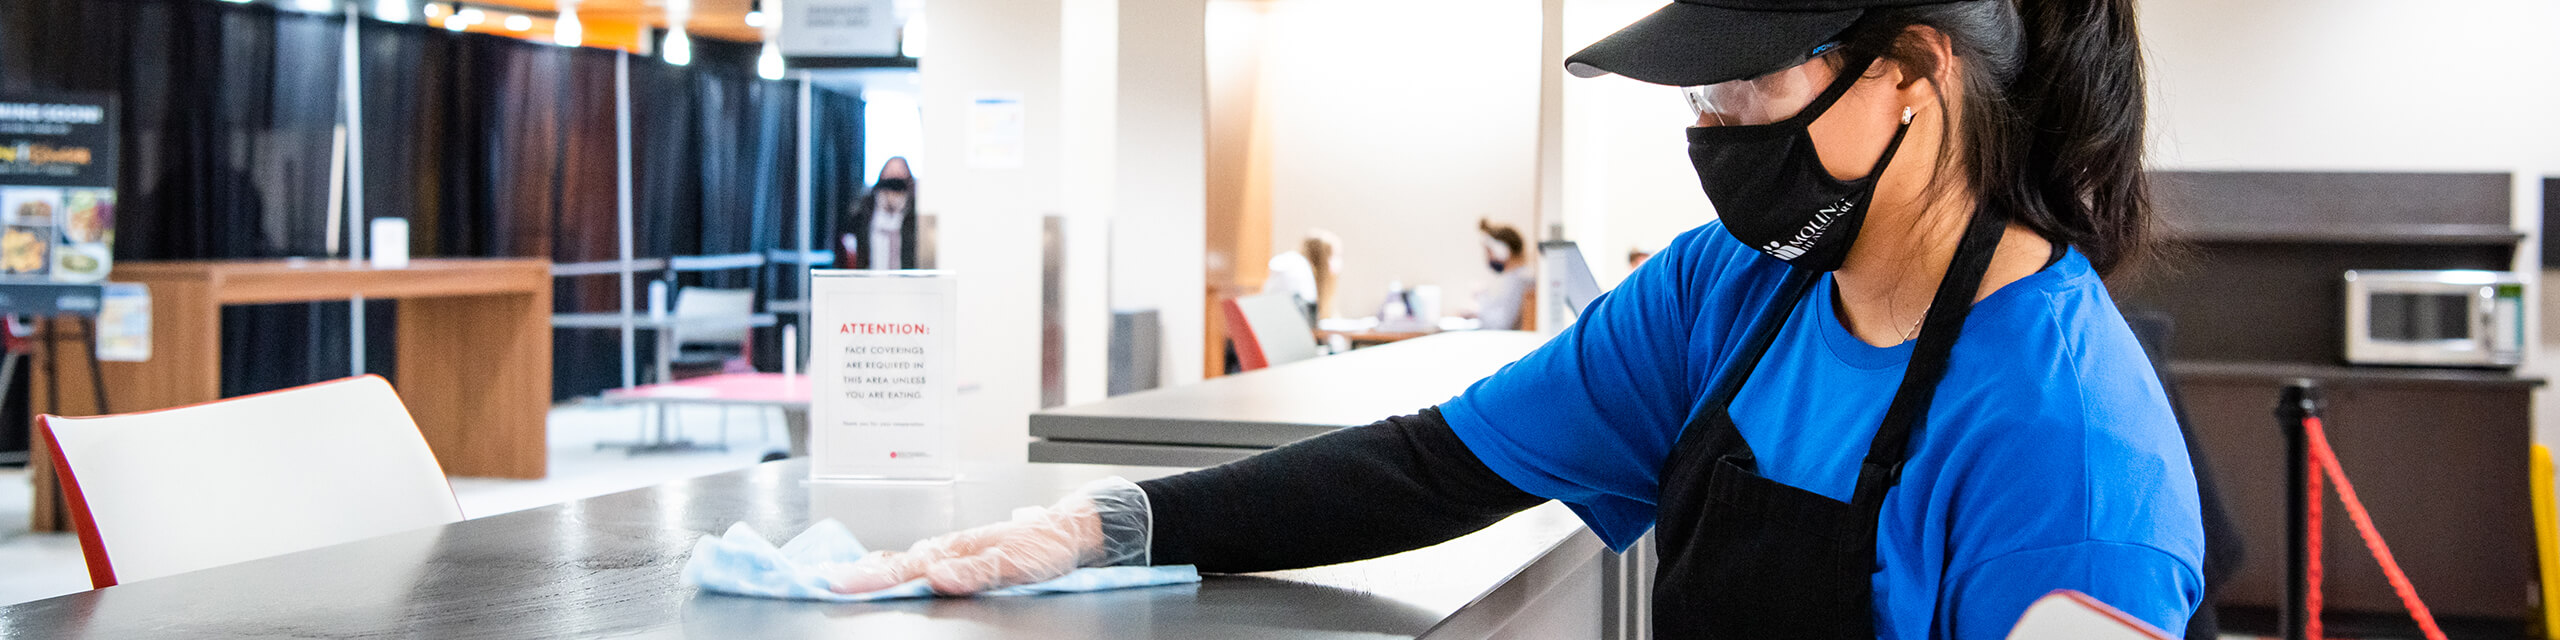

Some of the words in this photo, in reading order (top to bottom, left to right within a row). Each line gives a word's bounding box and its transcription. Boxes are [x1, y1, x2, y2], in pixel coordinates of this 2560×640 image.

[840, 323, 930, 335] ATTENTION:
[845, 346, 866, 355] FACE
[870, 346, 924, 355] COVERINGS
[846, 361, 861, 369] ARE
[866, 361, 910, 370] REQUIRED
[914, 361, 924, 369] IN
[843, 376, 863, 384] THIS
[866, 376, 889, 385] AREA
[892, 376, 926, 385] UNLESS
[845, 391, 865, 399] YOU
[868, 391, 884, 399] ARE
